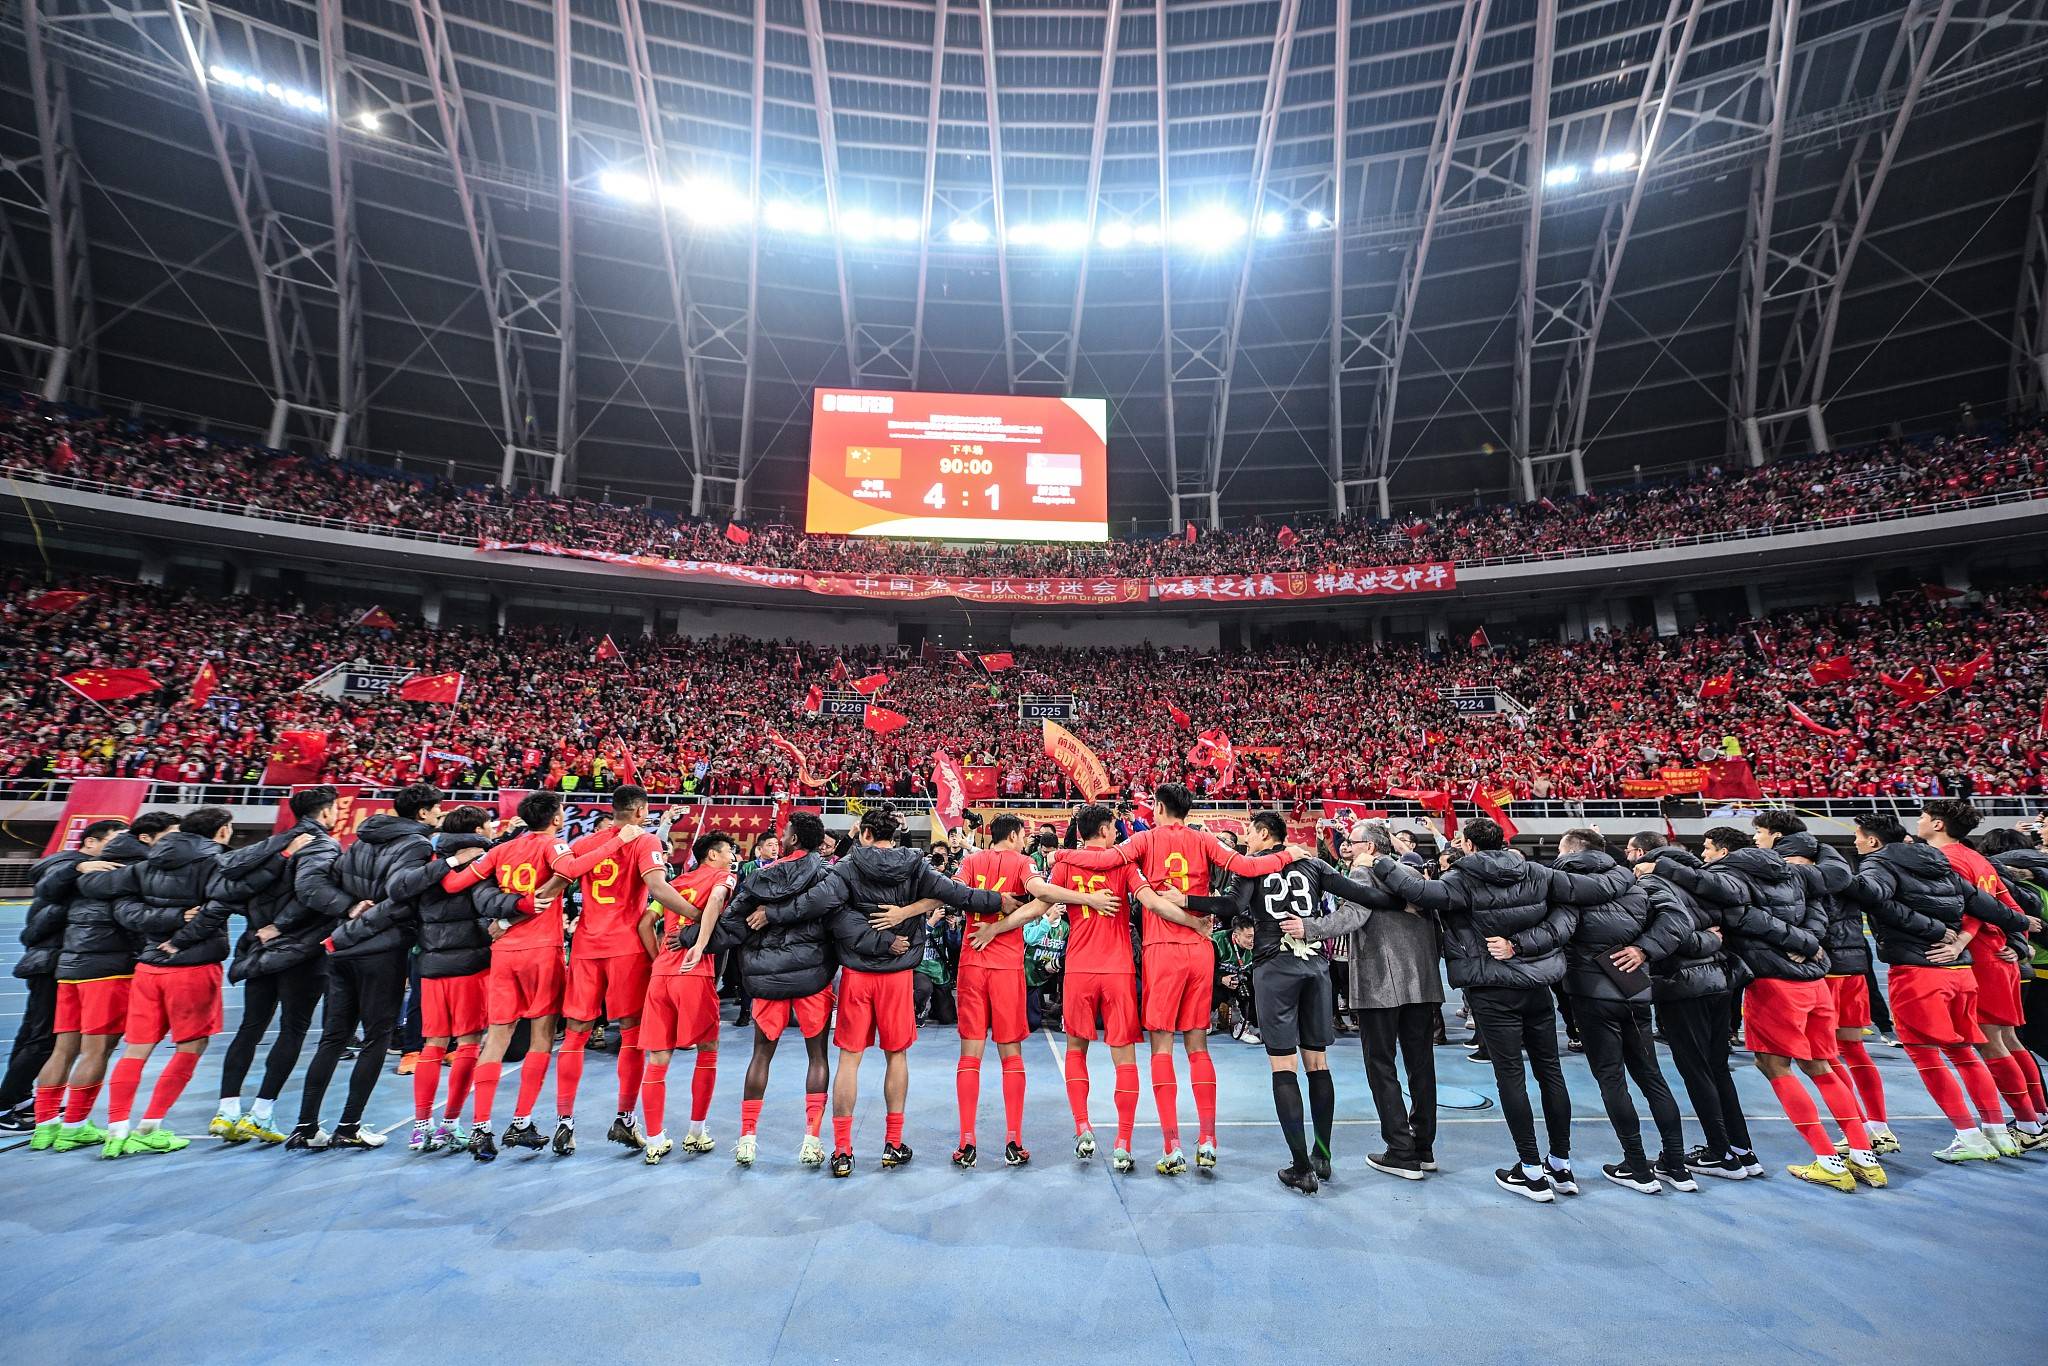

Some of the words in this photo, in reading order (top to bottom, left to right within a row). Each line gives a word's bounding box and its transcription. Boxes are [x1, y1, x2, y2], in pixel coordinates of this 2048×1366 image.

[950, 444, 983, 455] 下半场
[939, 458, 993, 475] 90:00
[923, 482, 946, 510] 4
[984, 484, 1001, 511] 1
[855, 577, 1118, 596] 中国龙之队球迷会
[855, 588, 898, 597] Chinese
[900, 588, 943, 598] Football
[1080, 594, 1118, 604] Dragon
[357, 677, 390, 690] D22
[831, 702, 862, 713] D226
[1031, 706, 1061, 718] D225
[593, 857, 619, 905] 2
[1164, 852, 1189, 893] 3
[1263, 870, 1313, 920] 23
